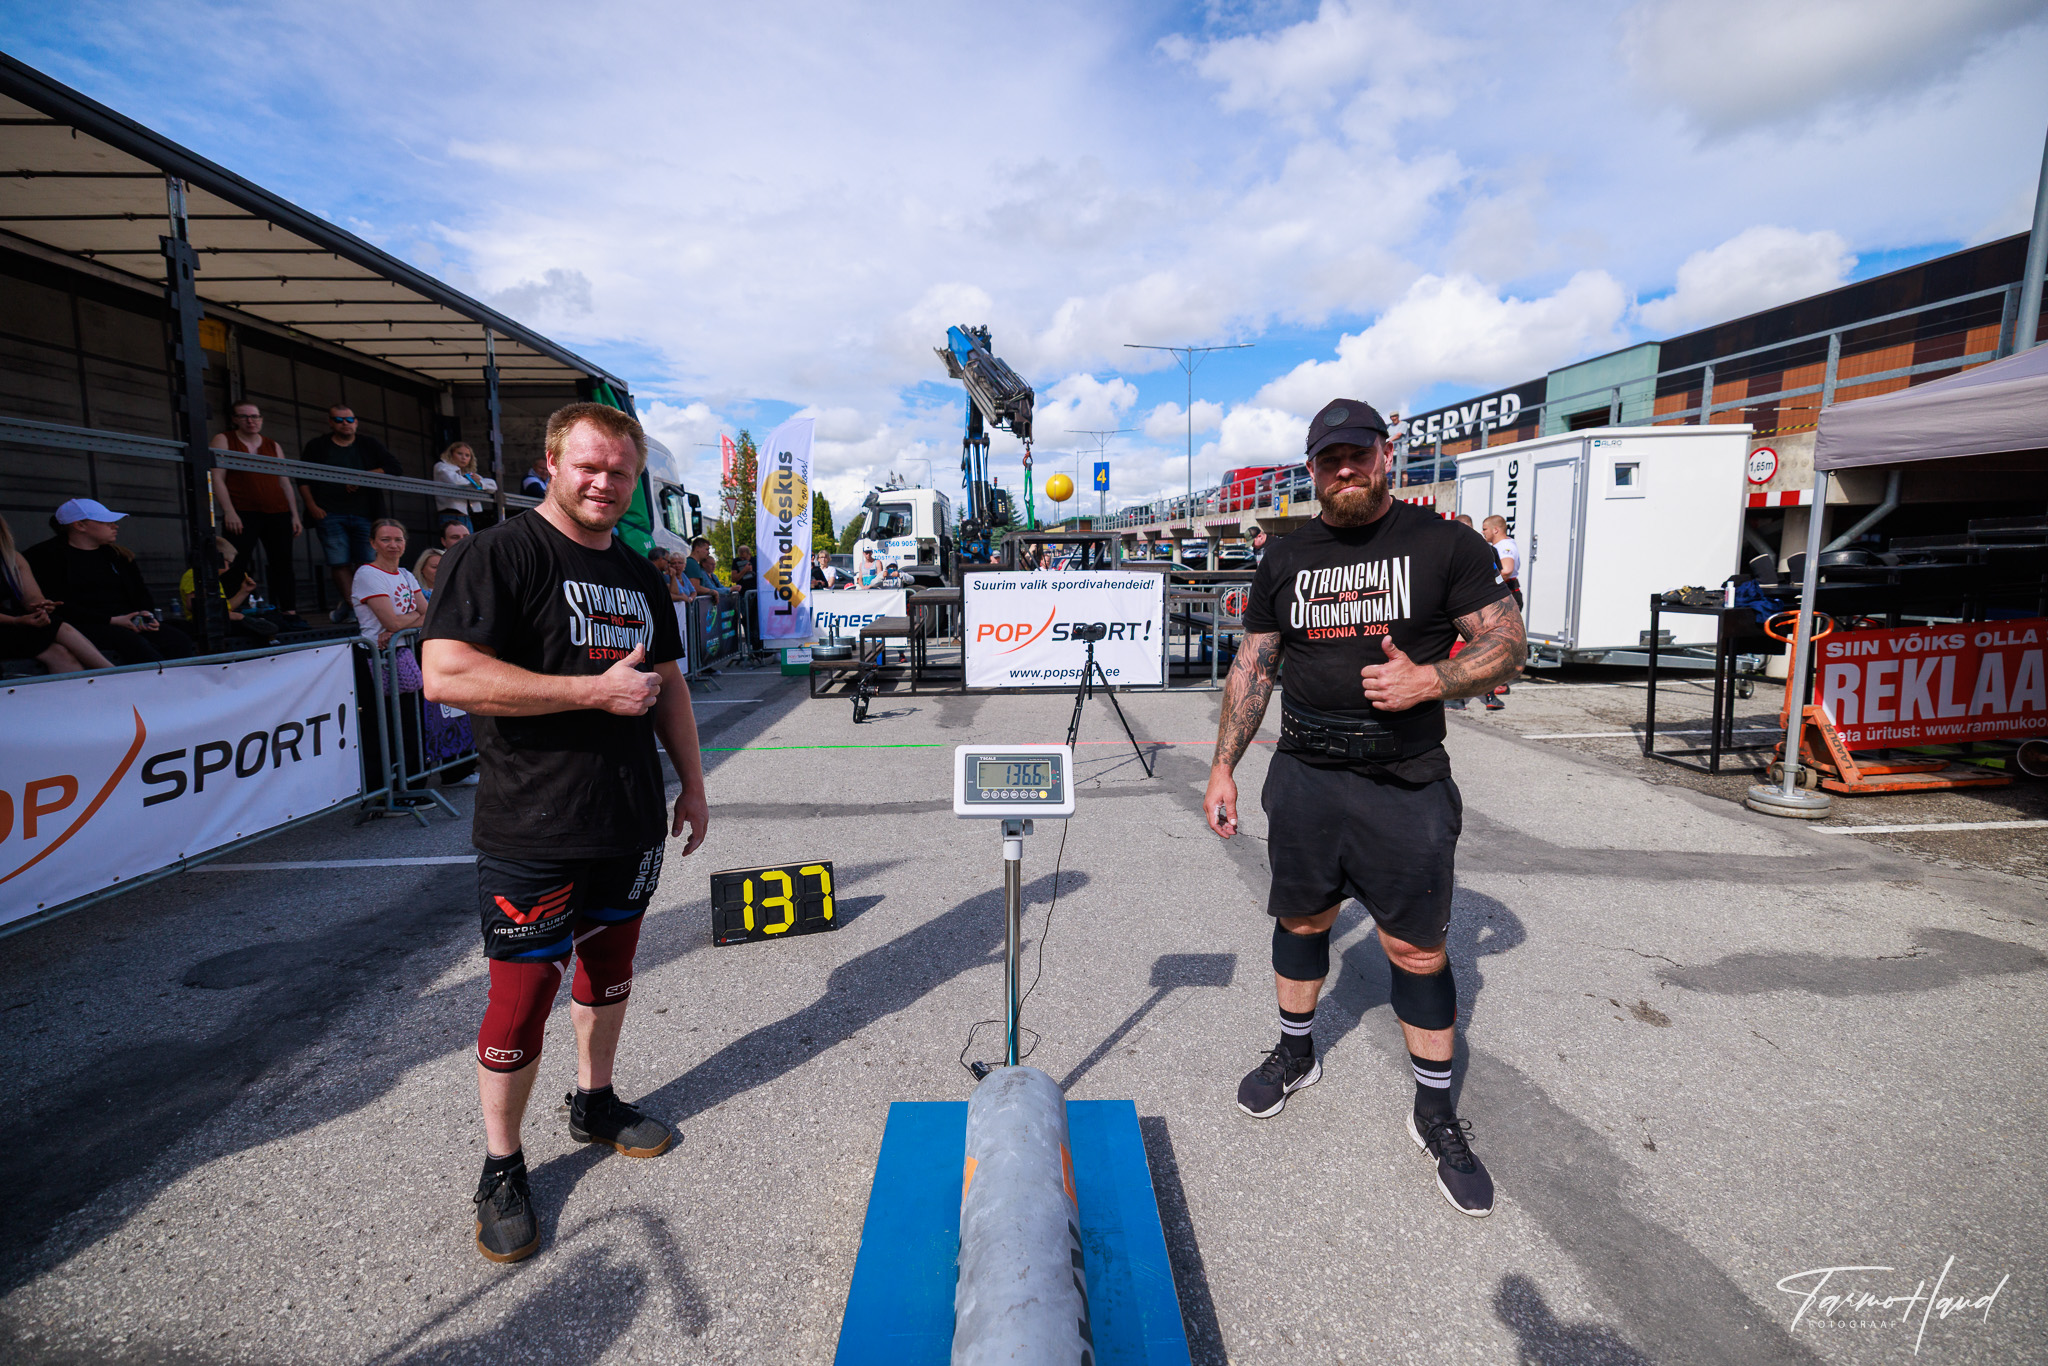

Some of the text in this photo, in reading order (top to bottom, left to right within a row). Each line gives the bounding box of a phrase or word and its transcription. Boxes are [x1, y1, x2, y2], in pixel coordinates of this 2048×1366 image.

[1405, 393, 1521, 448] SERVED
[1096, 468, 1107, 484] 4
[1750, 461, 1774, 473] 1,65m
[774, 451, 793, 616] Lõunakeskus
[973, 579, 1155, 592] Suurim valik spordivahendeid!
[1294, 556, 1411, 605] STRONGMAN
[1290, 590, 1411, 629] STRONGWOMAN
[1338, 591, 1359, 602] PRO
[976, 623, 1033, 643] POP
[1307, 624, 1389, 639] ESTONIA 2026
[1825, 639, 1880, 658] SIIN
[1888, 633, 1966, 654] VÕIKS
[1974, 629, 2039, 648] OLLA
[1822, 649, 2047, 726] REKLAA
[1824, 724, 1853, 769] LAADUR
[1866, 725, 1921, 741] üritust:
[141, 703, 348, 808] SPORT!
[1006, 764, 1042, 786] 136.6
[628, 847, 654, 900] REMES
[743, 864, 834, 935] 137
[494, 925, 536, 935] VOSTOK
